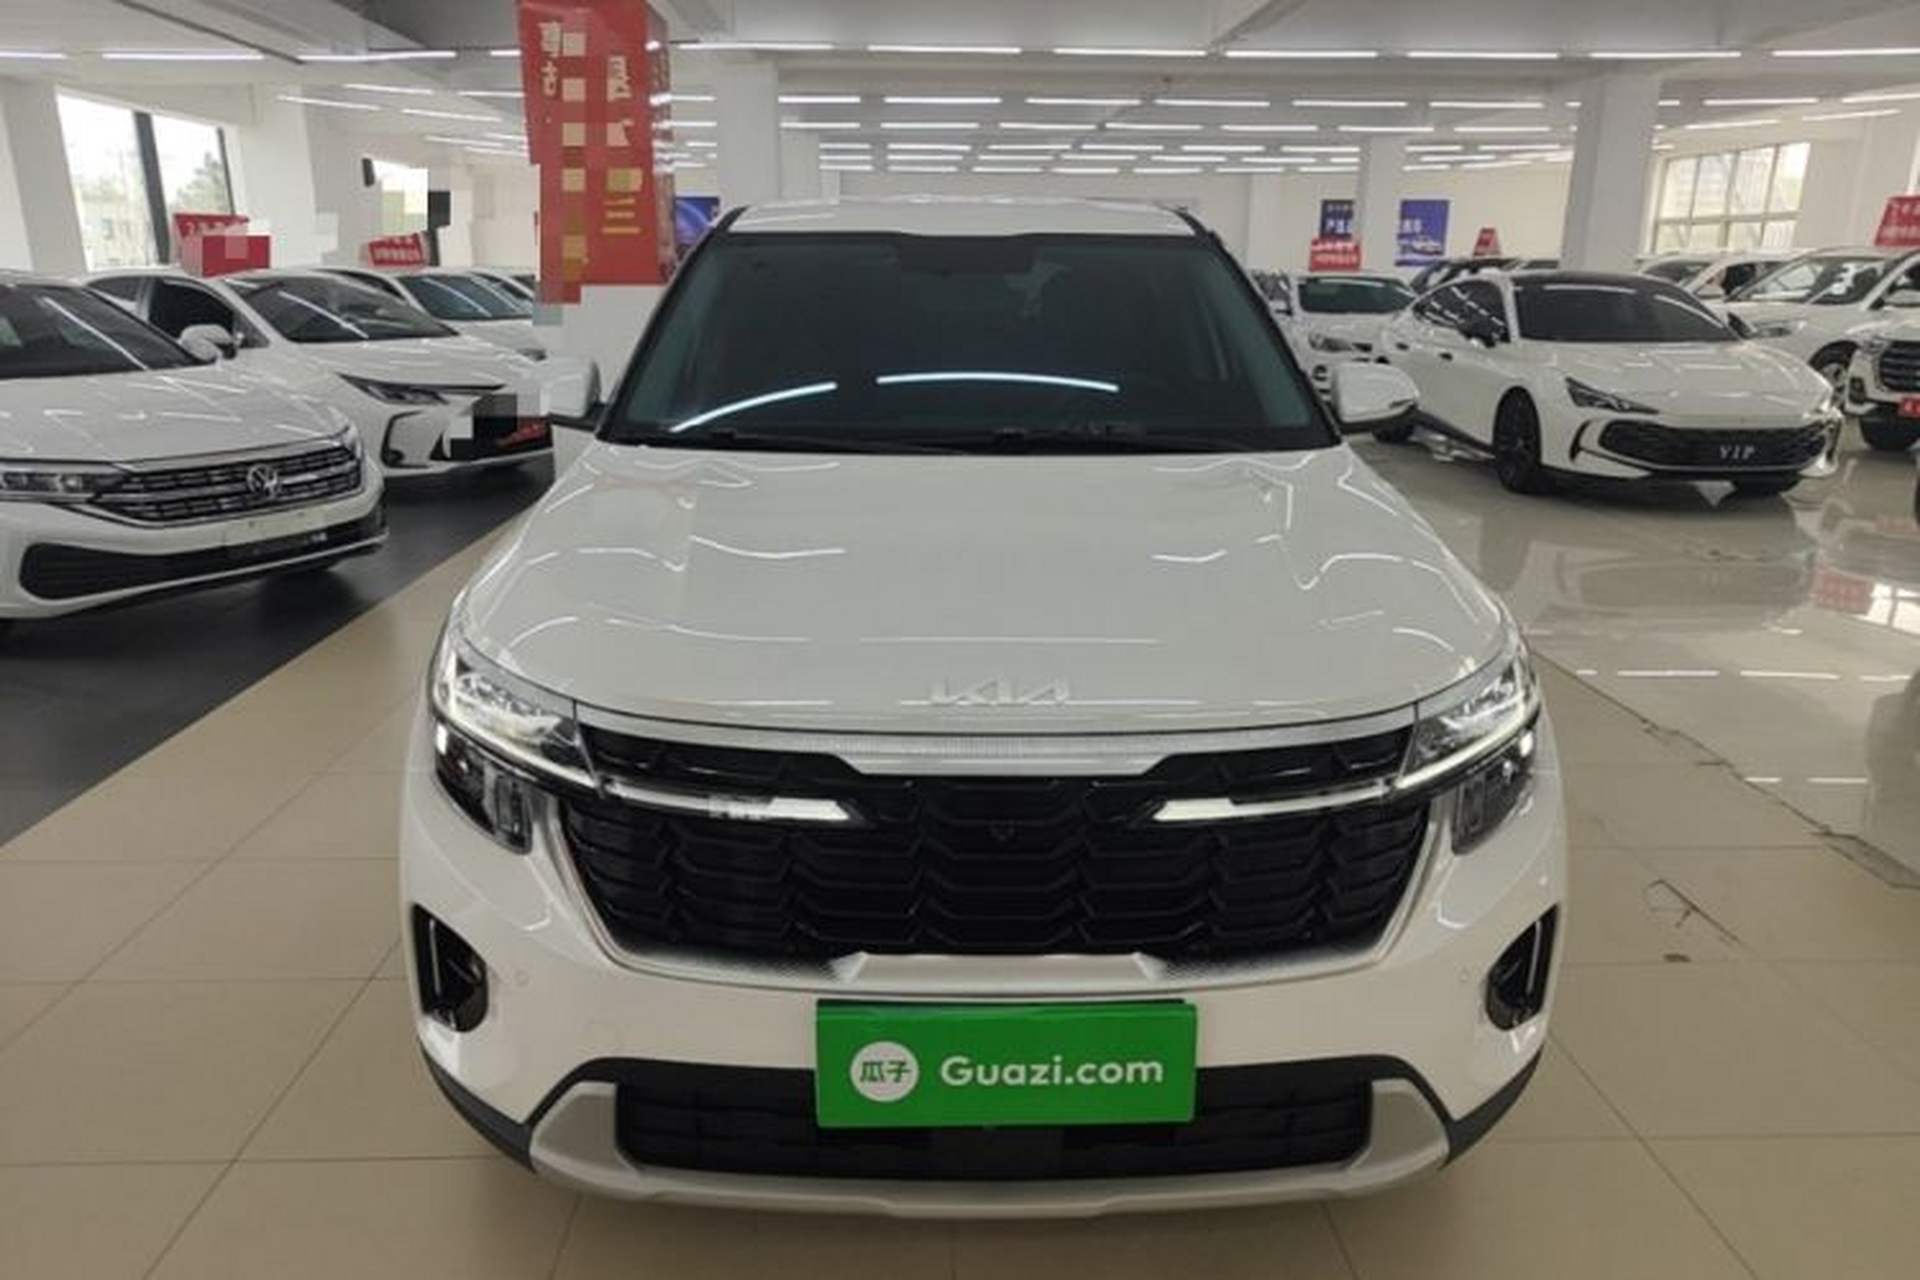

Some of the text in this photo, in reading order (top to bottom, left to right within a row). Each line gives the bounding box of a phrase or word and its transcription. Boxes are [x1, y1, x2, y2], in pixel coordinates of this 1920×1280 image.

[1719, 443, 1755, 460] VIP
[930, 679, 1070, 706] KIA
[859, 1055, 1164, 1087] 瓜子 Guazi.com
